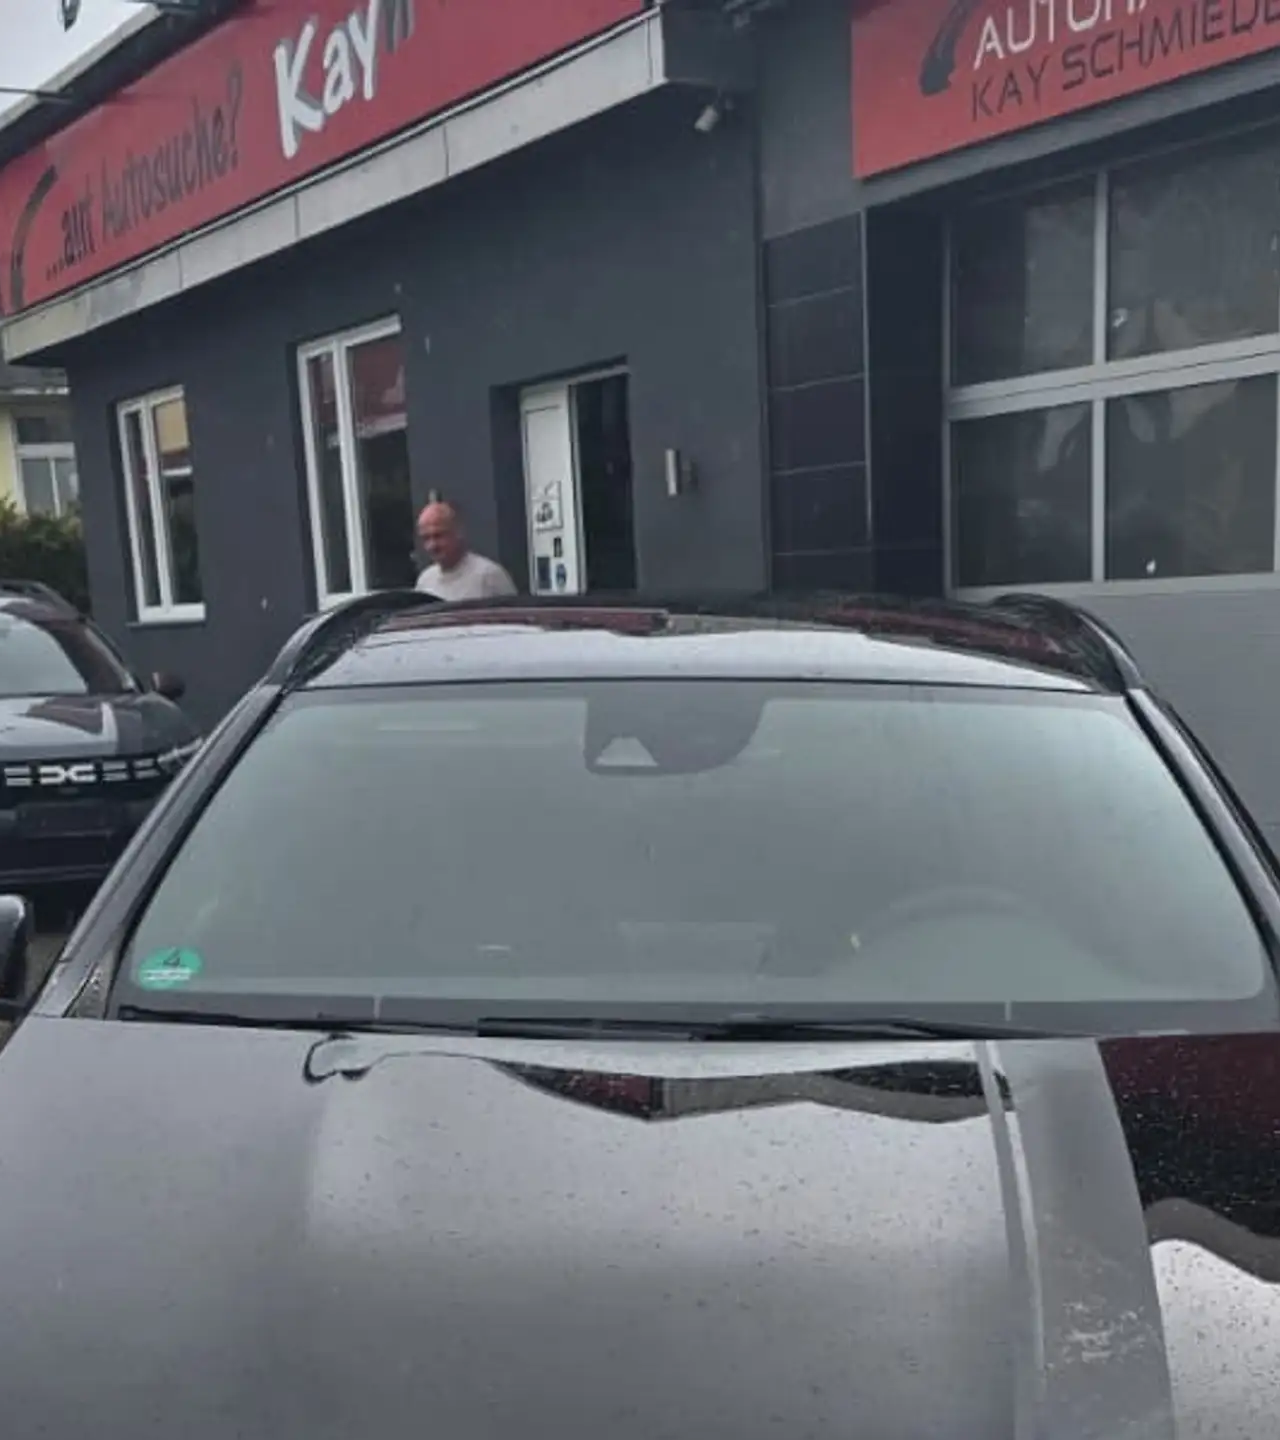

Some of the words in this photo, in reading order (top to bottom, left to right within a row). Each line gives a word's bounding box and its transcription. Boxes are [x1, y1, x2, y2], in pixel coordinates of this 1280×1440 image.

[973, 0, 1147, 70] AUTO
[273, 0, 381, 160] Kay
[972, 55, 1050, 122] KAY
